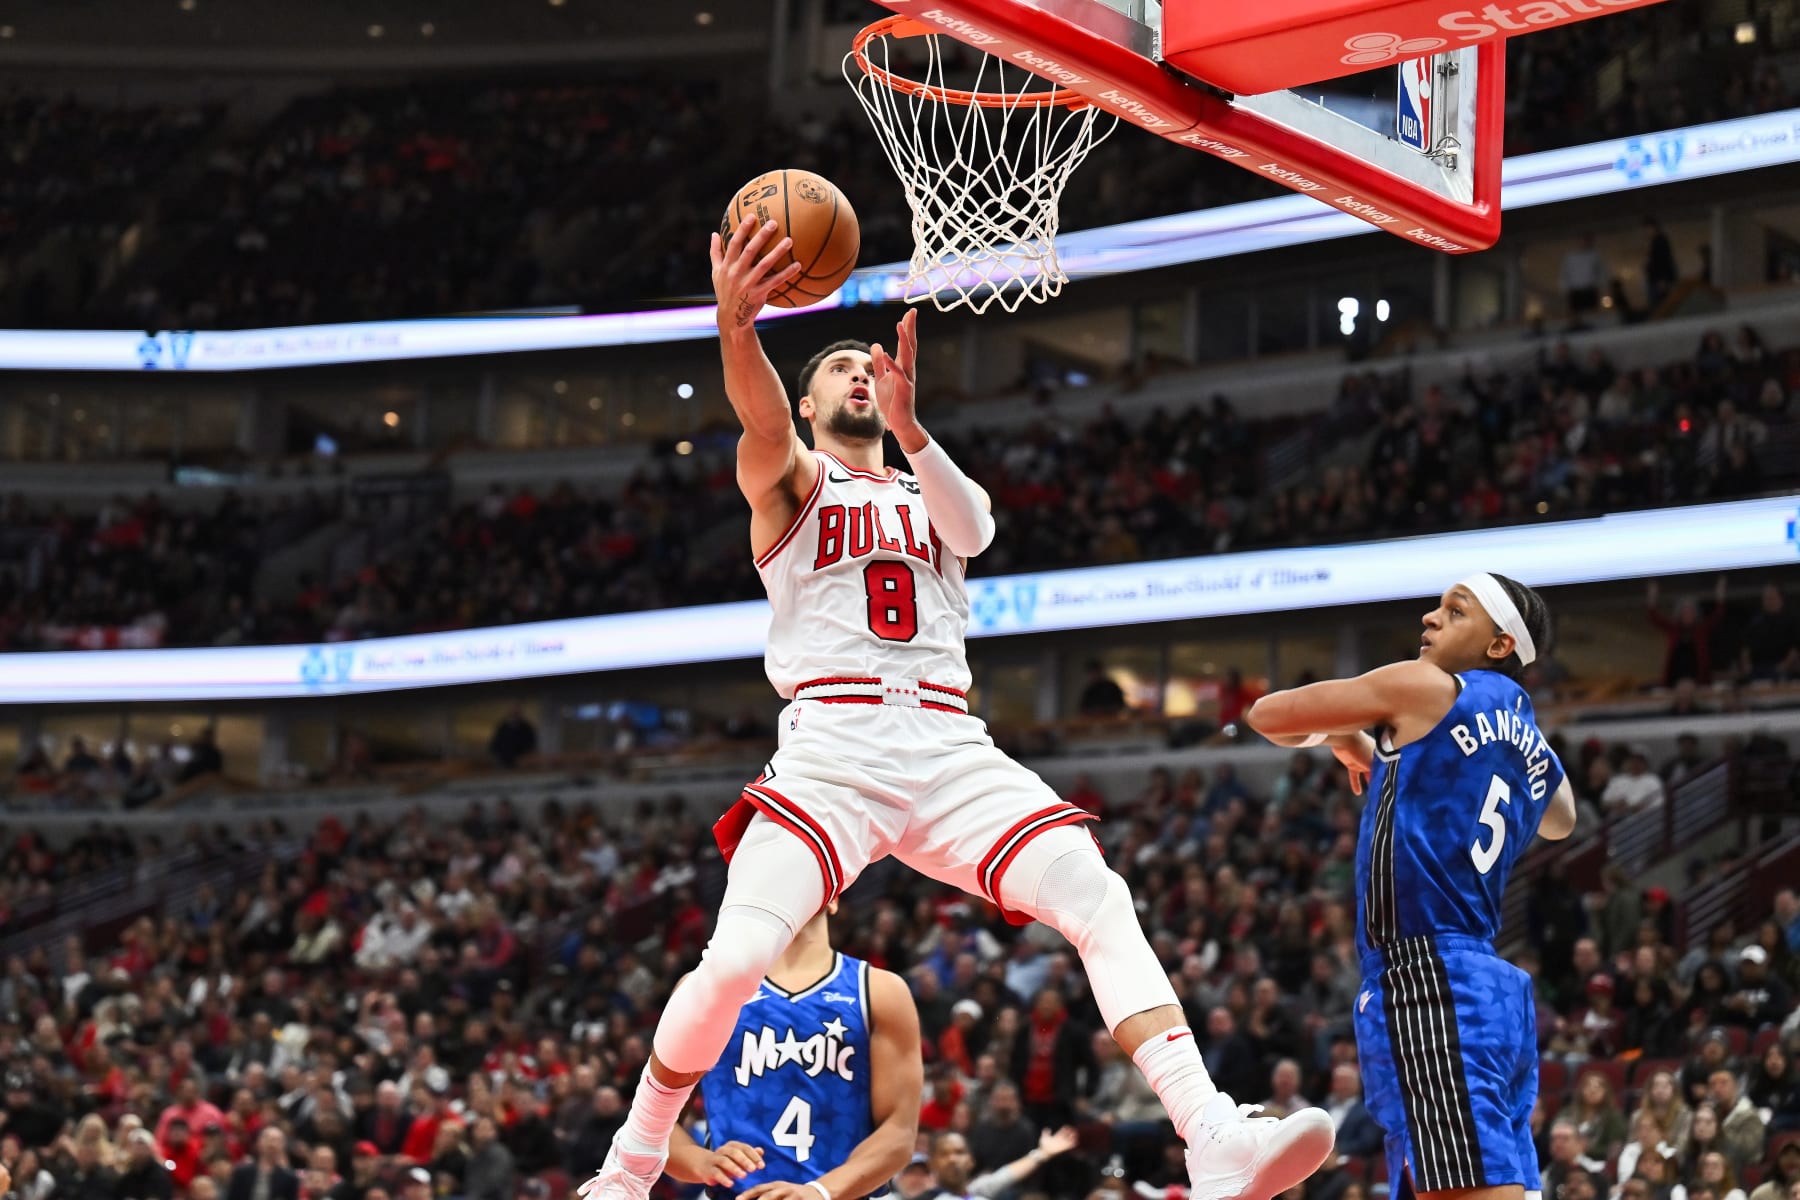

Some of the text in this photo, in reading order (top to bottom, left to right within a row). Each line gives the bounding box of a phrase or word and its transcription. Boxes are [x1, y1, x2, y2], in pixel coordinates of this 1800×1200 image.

[921, 9, 1003, 45] betway
[1012, 50, 1091, 86] betway
[1098, 89, 1172, 127] betway
[1180, 133, 1251, 157] betway
[1402, 114, 1418, 141] NBA
[1258, 163, 1328, 193] betway
[1334, 195, 1400, 225] betway
[1404, 228, 1469, 251] betway
[863, 559, 918, 643] 8
[1450, 708, 1550, 802] BANCHERO
[1470, 773, 1511, 875] 5
[821, 991, 856, 1005] Disney
[771, 1095, 816, 1163] 4
